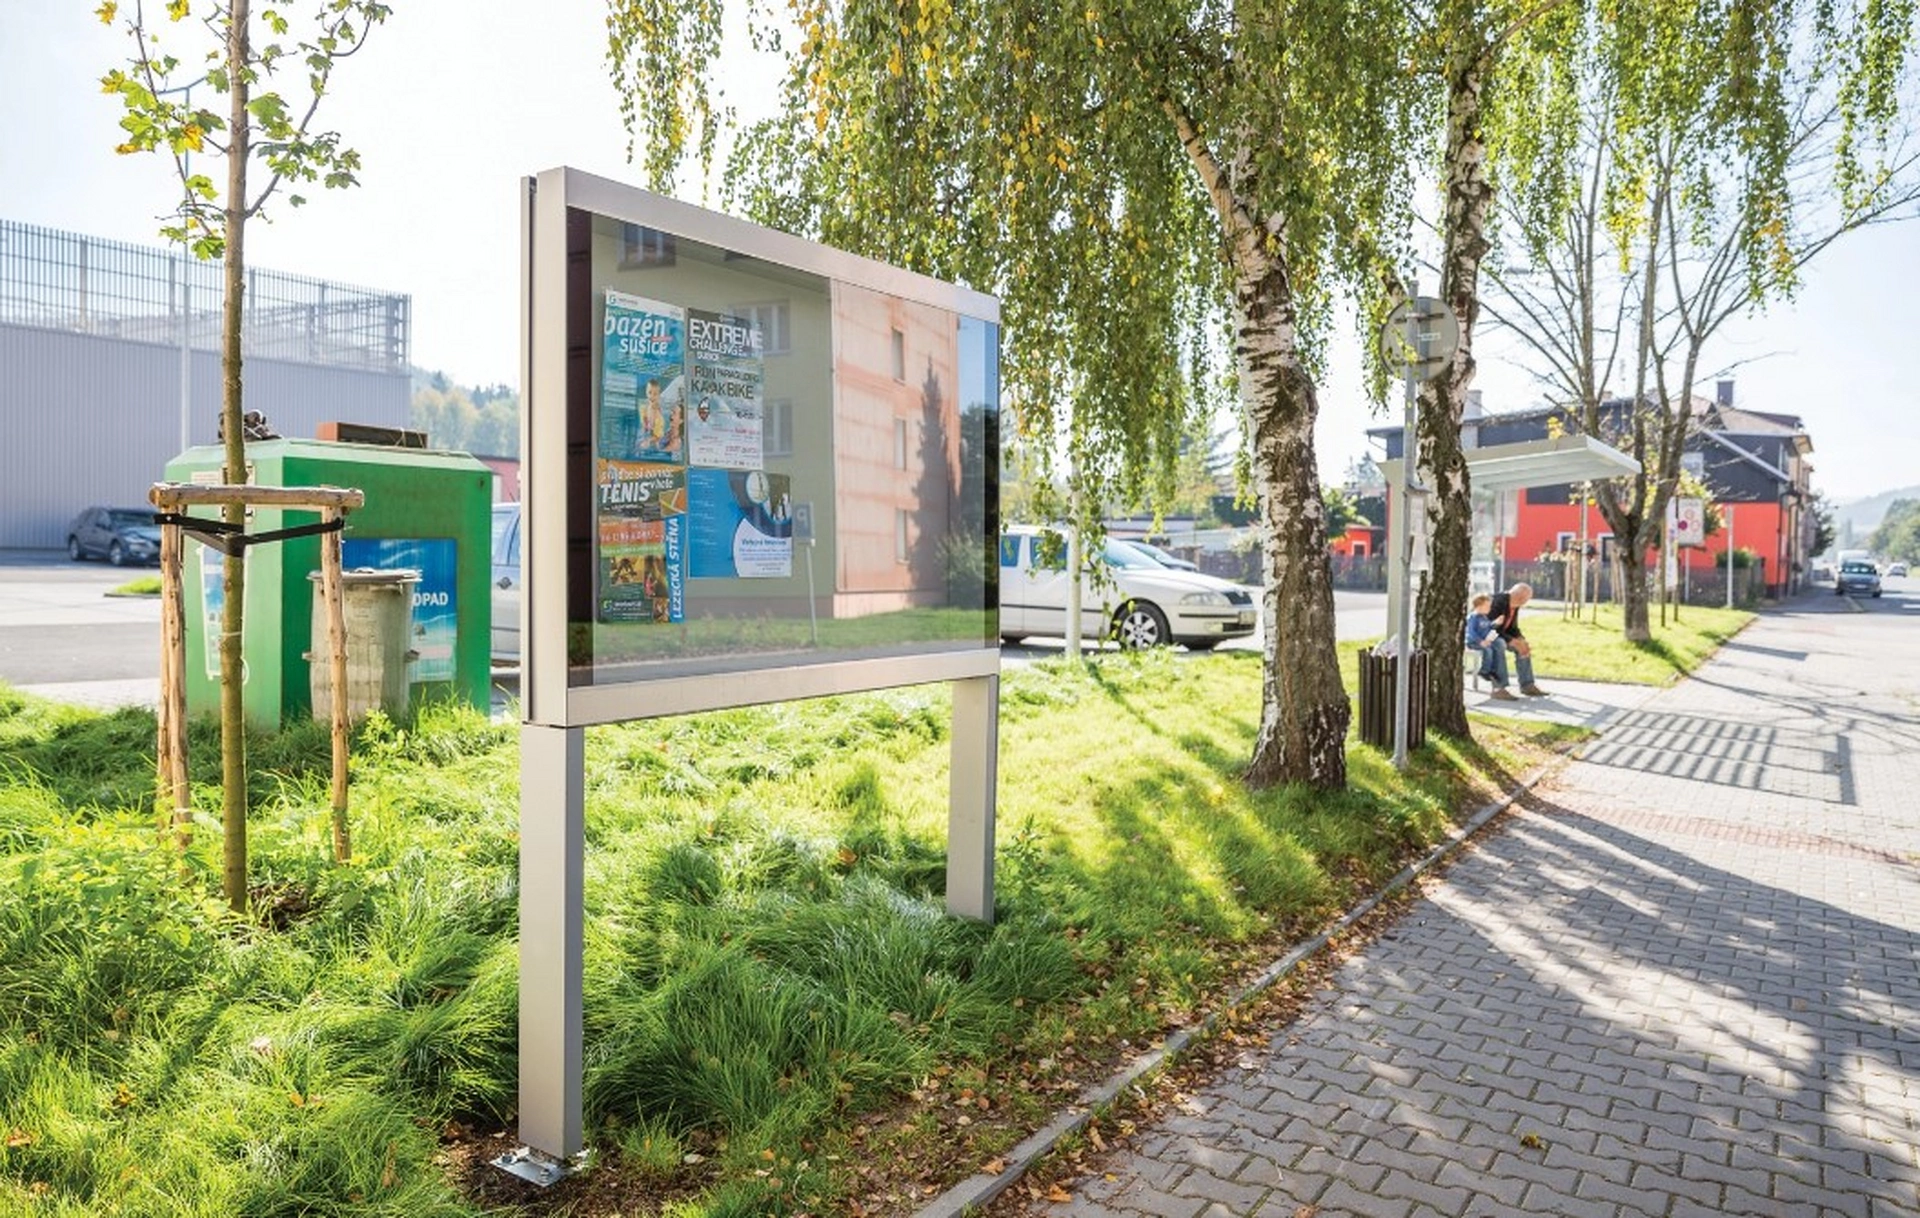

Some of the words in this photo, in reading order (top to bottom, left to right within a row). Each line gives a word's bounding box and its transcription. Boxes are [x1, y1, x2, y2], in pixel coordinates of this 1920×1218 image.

[604, 307, 666, 337] bazén
[689, 318, 763, 349] EXTREME
[619, 336, 669, 355] sušice
[727, 382, 755, 400] BIKE
[600, 481, 650, 503] TENIS
[665, 517, 680, 559] STĚNA
[667, 563, 684, 618] LEZECKÁ
